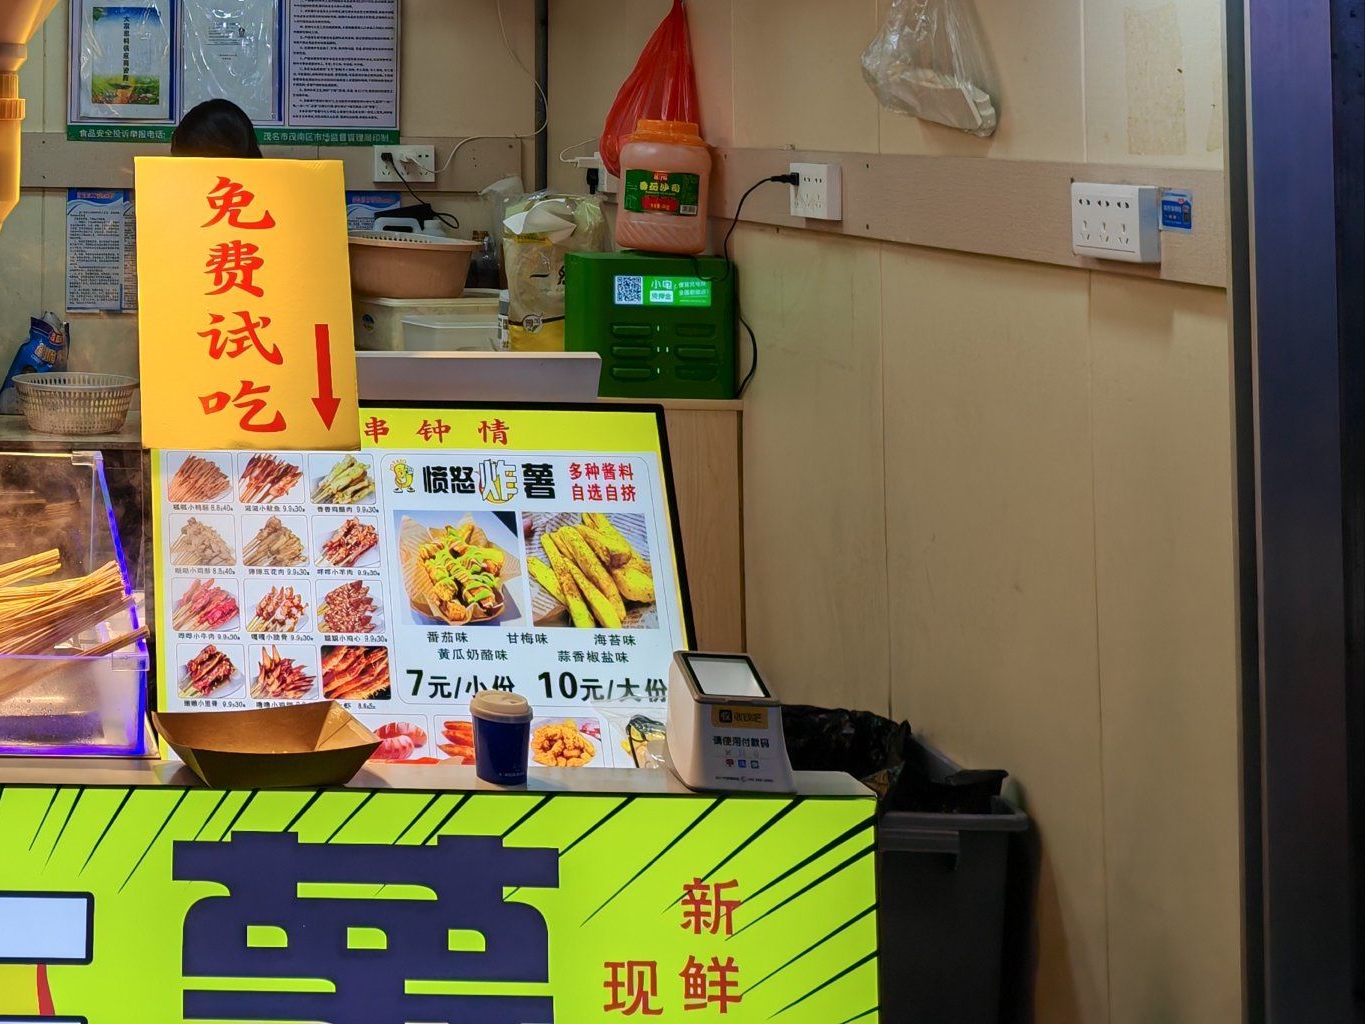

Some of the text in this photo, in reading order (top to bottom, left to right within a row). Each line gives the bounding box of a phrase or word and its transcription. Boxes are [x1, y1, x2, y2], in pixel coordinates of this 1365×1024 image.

[196, 175, 287, 434] 免费试吃
[363, 416, 510, 446] 串钟情
[422, 458, 557, 503] 愤怒炸薯
[569, 462, 634, 481] 多种酱料
[572, 483, 637, 502] 自选自挤
[426, 631, 637, 646] 番茄味 甘梅味 海苔味
[437, 648, 630, 664] 黄瓜奶酪味 蒜香椒盐味
[537, 671, 668, 703] 10元/大份
